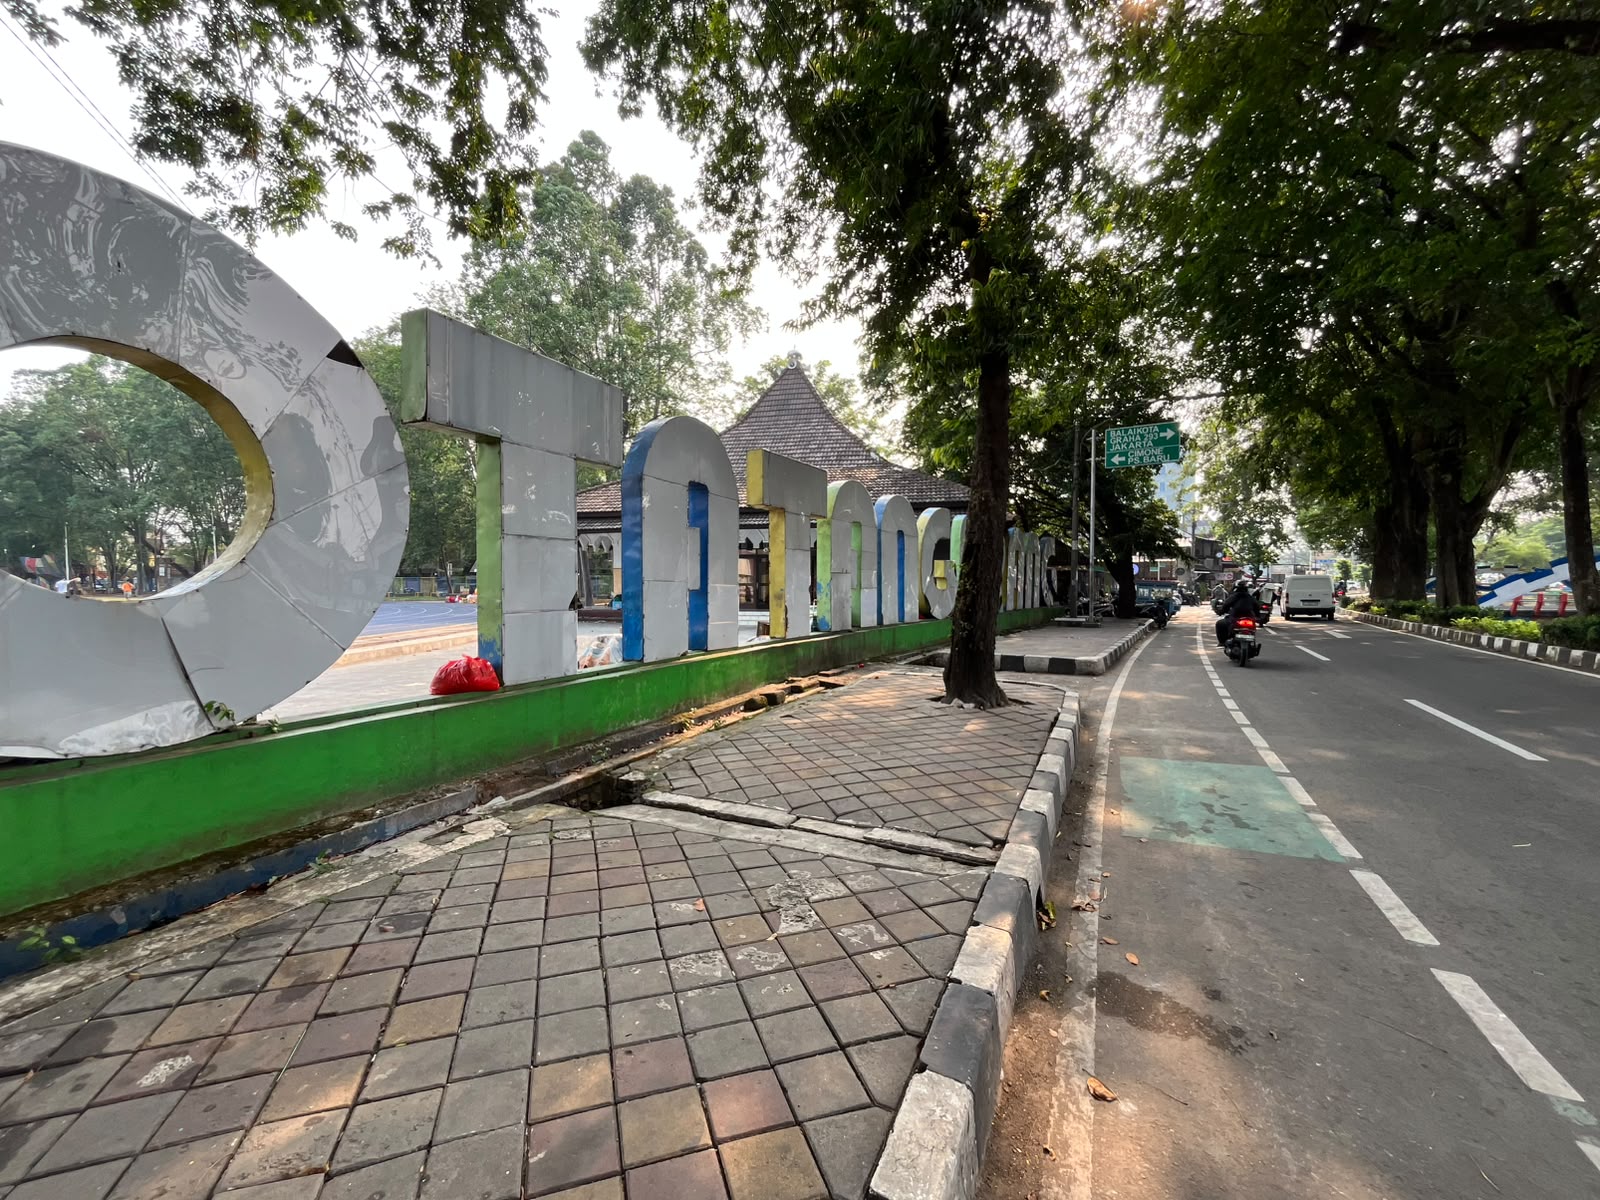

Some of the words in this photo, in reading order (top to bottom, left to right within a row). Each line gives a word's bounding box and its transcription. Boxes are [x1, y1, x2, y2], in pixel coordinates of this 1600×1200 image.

[1109, 425, 1160, 437] BALAIKOTA
[1109, 434, 1141, 445] GRAHA
[1143, 432, 1159, 441] 293
[1109, 440, 1154, 452] JAKARTA
[1127, 447, 1164, 458] CIMONE
[1127, 457, 1143, 465] PS.
[1143, 454, 1170, 463] BARU
